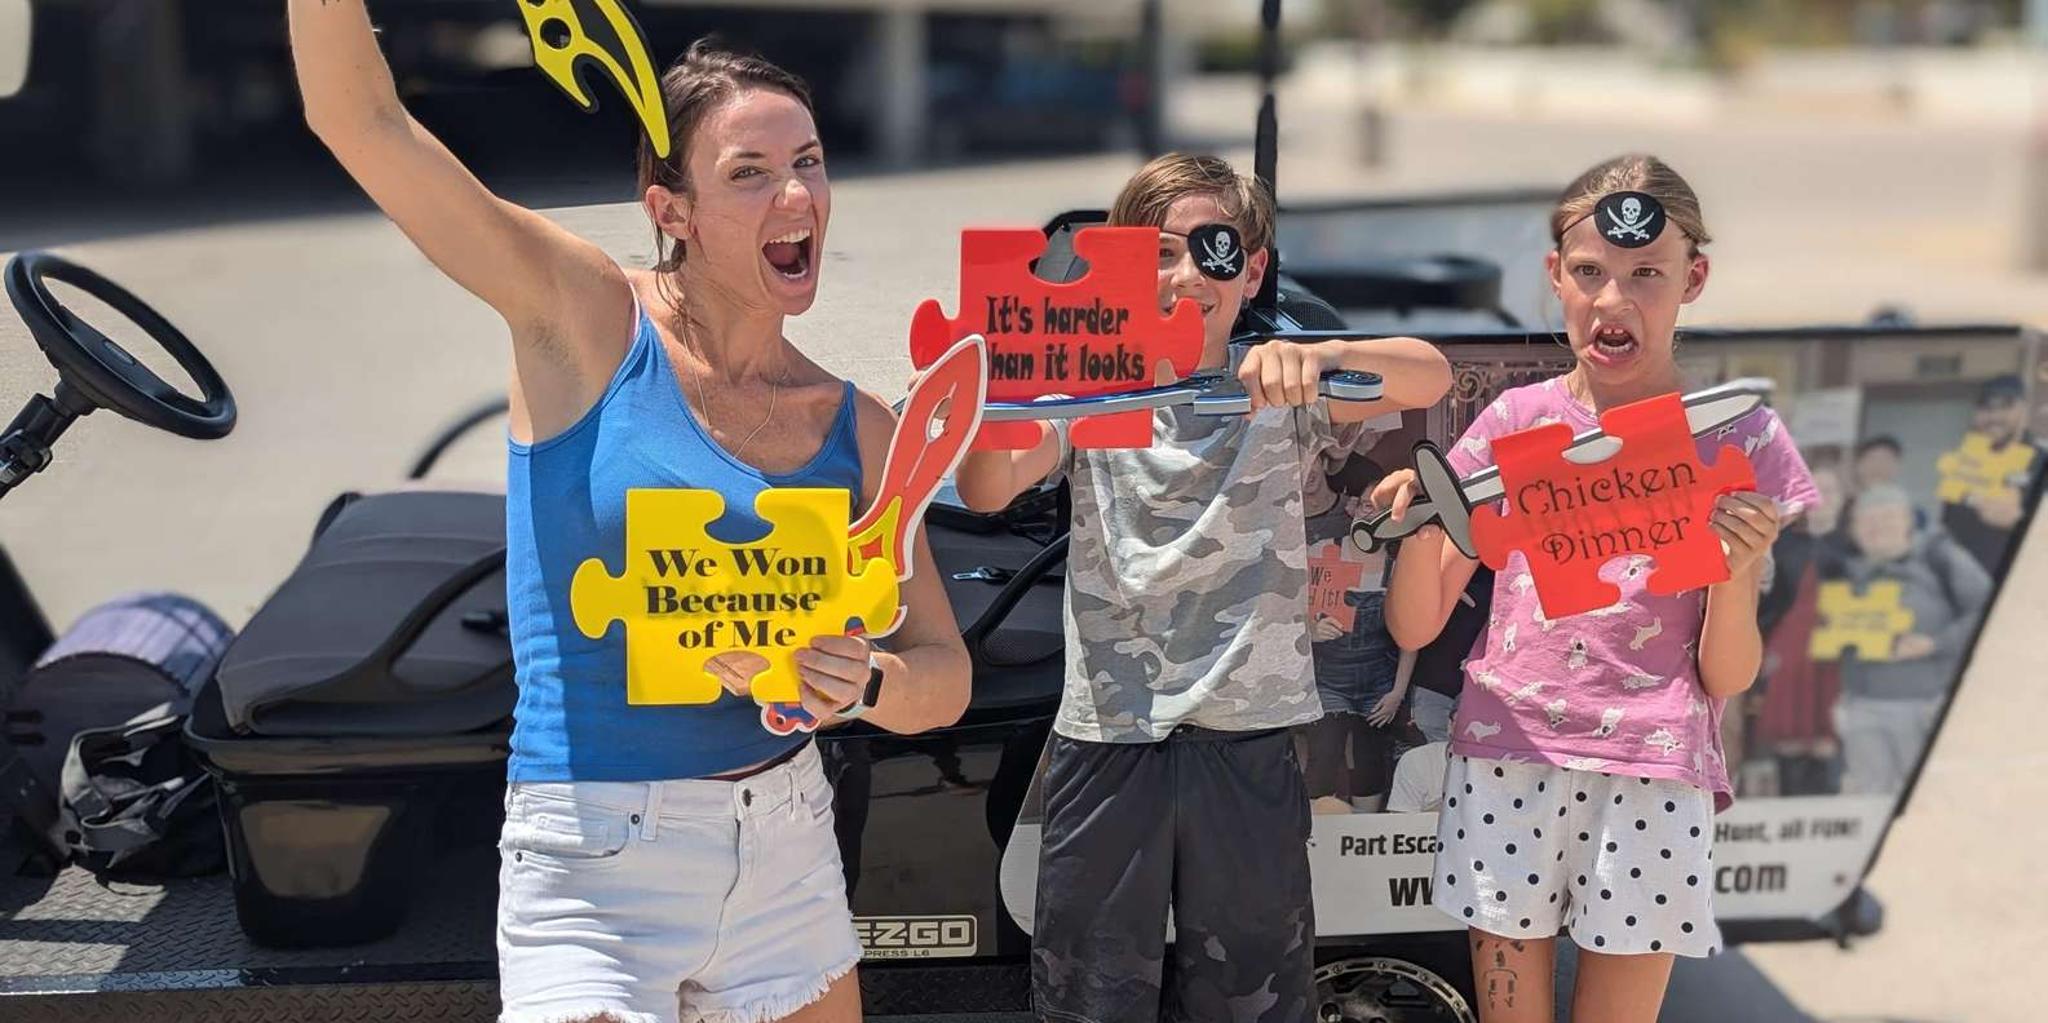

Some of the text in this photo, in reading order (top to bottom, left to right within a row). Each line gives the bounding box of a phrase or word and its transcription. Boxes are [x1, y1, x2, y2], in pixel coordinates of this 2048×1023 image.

[985, 296, 1129, 335] It's harder
[986, 343, 1145, 382] han it looks
[1517, 462, 1697, 516] Chicken
[1541, 515, 1690, 566] Dinner
[646, 547, 828, 578] We Won
[644, 585, 822, 615] Because
[678, 619, 797, 649] of Me
[1340, 834, 1387, 857] Part
